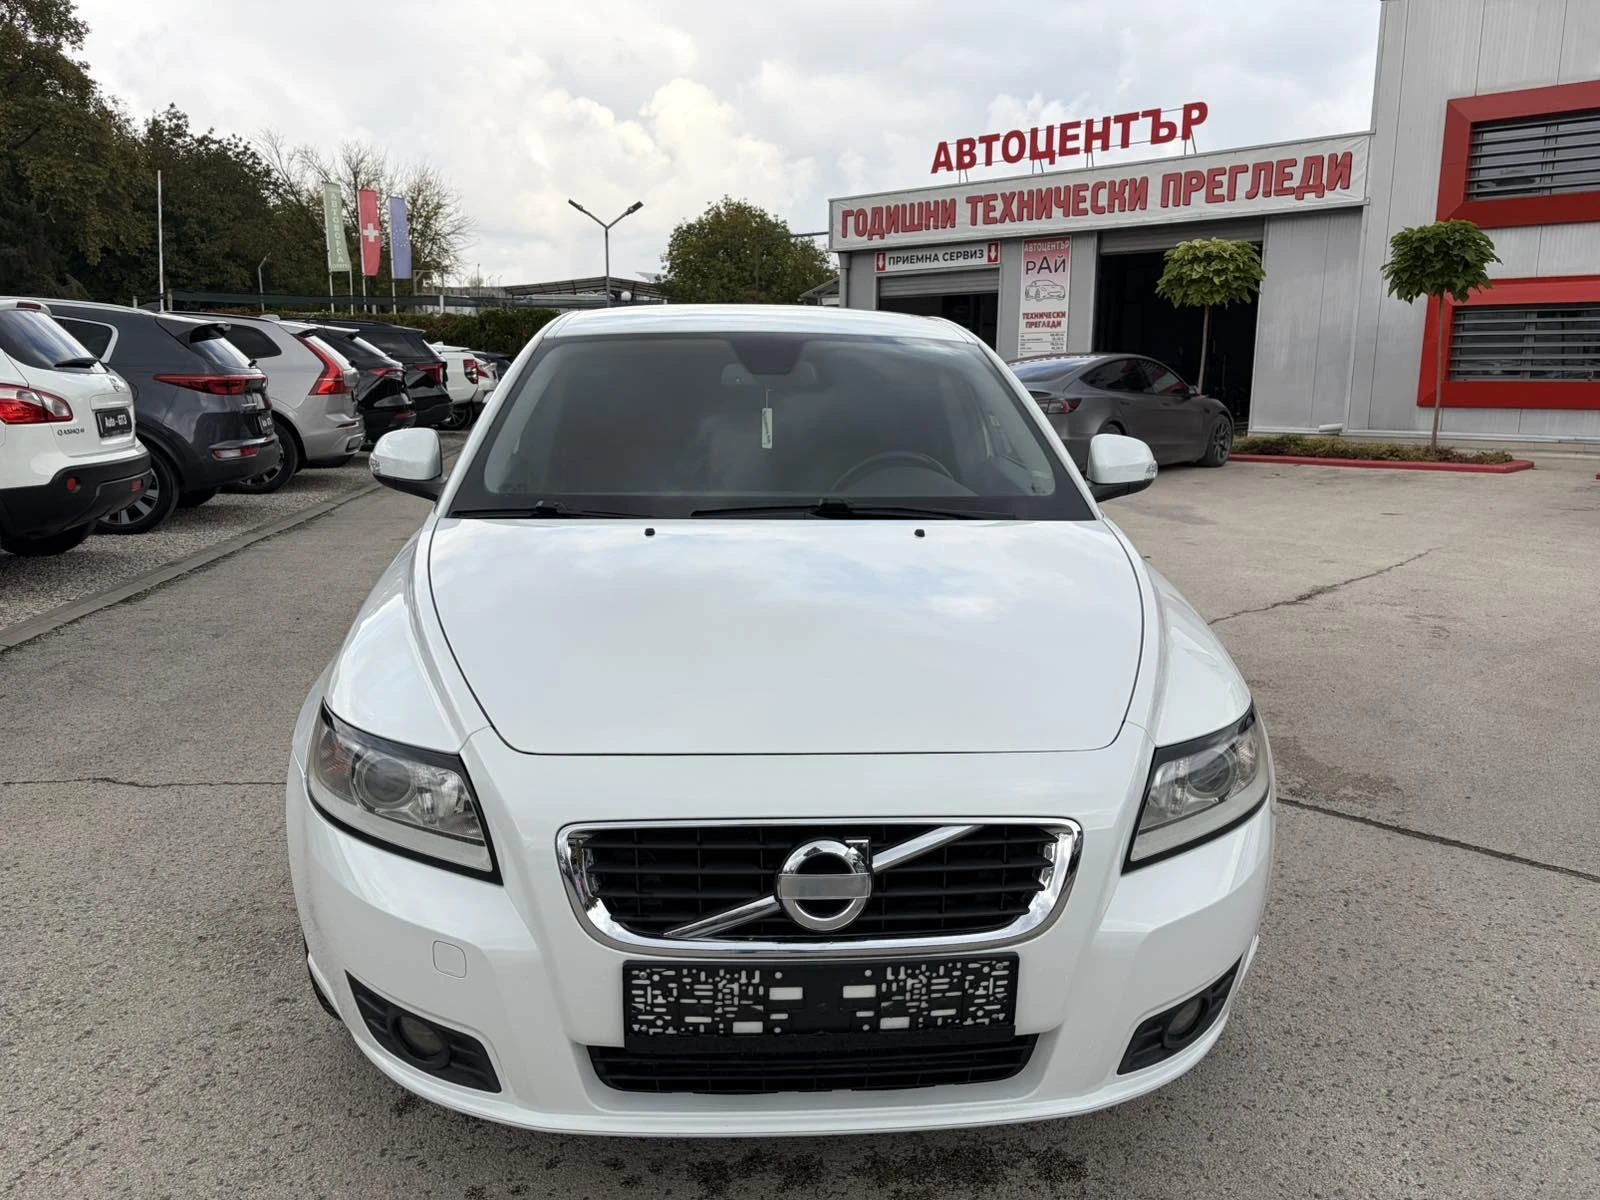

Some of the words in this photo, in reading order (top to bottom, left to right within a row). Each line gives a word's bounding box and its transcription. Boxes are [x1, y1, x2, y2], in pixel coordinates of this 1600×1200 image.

[930, 101, 1209, 174] АВТОЦЕНТЪР
[841, 197, 957, 241] ГОДИШНИ
[966, 175, 1150, 226] ТЕХНИЧЕСКИ
[1160, 151, 1354, 208] ПРЕГЛЕДИ
[1024, 240, 1070, 252] АВТОЦЕНТЪР
[888, 253, 940, 266] ПРИЕМНА
[942, 248, 985, 262] СЕРВИЗ
[1022, 310, 1067, 320] ТЕХНИЧЕСКИ
[1025, 320, 1062, 329] ПРЕГЛЕДИ
